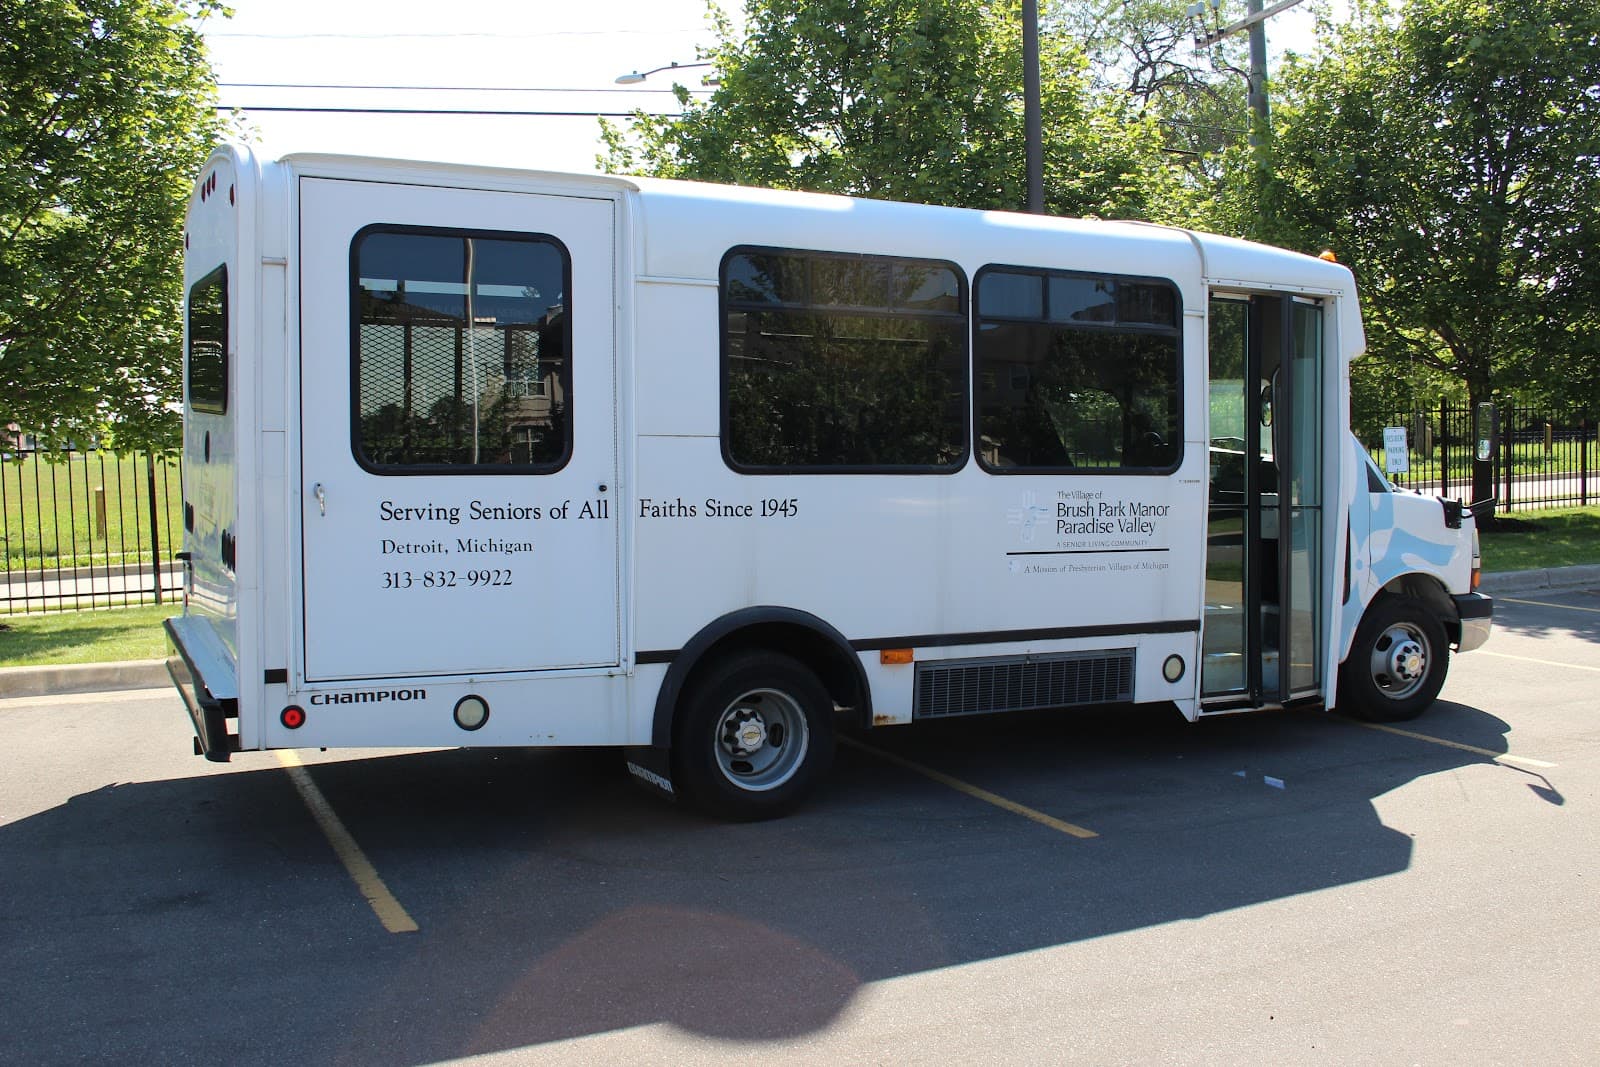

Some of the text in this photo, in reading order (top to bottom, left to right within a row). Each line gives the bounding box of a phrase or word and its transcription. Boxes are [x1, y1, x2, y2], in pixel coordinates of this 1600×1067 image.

[1057, 490, 1103, 501] The Village of
[379, 498, 798, 525] Serving Seniors of All Faiths Since 1945
[1056, 500, 1170, 518] Brush Park Manor
[1056, 517, 1156, 537] Paradise Valley
[381, 537, 534, 556] Detroit, Michigan
[1062, 540, 1087, 548] SENIOR
[1088, 540, 1111, 548] LIVING
[1111, 539, 1149, 547] COMMUNITY
[1024, 565, 1031, 574] A
[1108, 562, 1132, 573] Villages
[1141, 561, 1169, 572] Michigan
[381, 568, 513, 590] 313-832-9922
